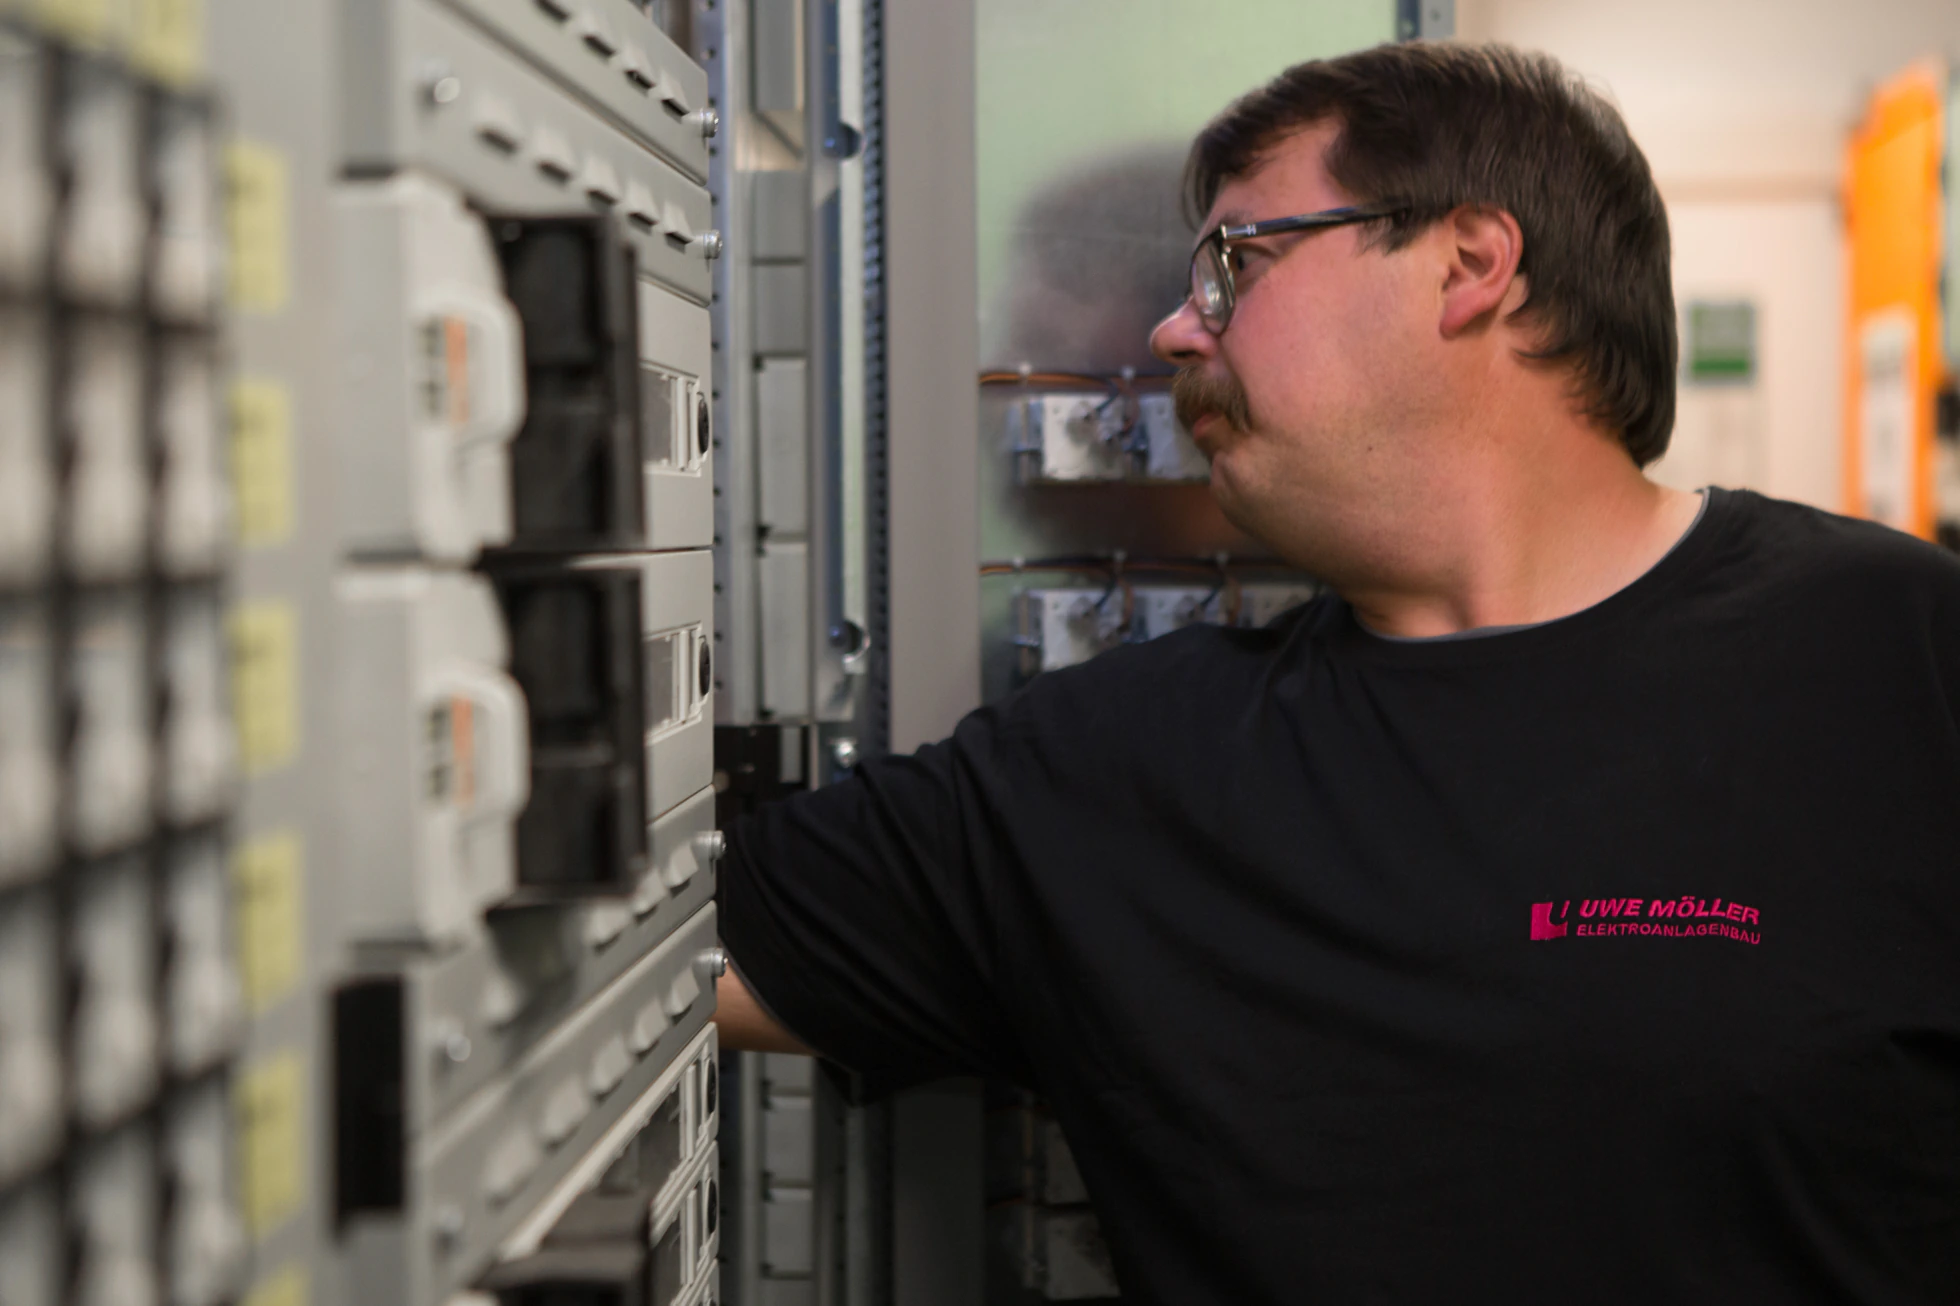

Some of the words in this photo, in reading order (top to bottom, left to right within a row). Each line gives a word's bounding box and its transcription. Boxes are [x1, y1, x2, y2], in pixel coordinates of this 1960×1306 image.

[1578, 898, 1644, 918] UWE
[1648, 896, 1761, 925] MÖLLER
[1576, 922, 1761, 945] ELEKTROANLAGENBAU
